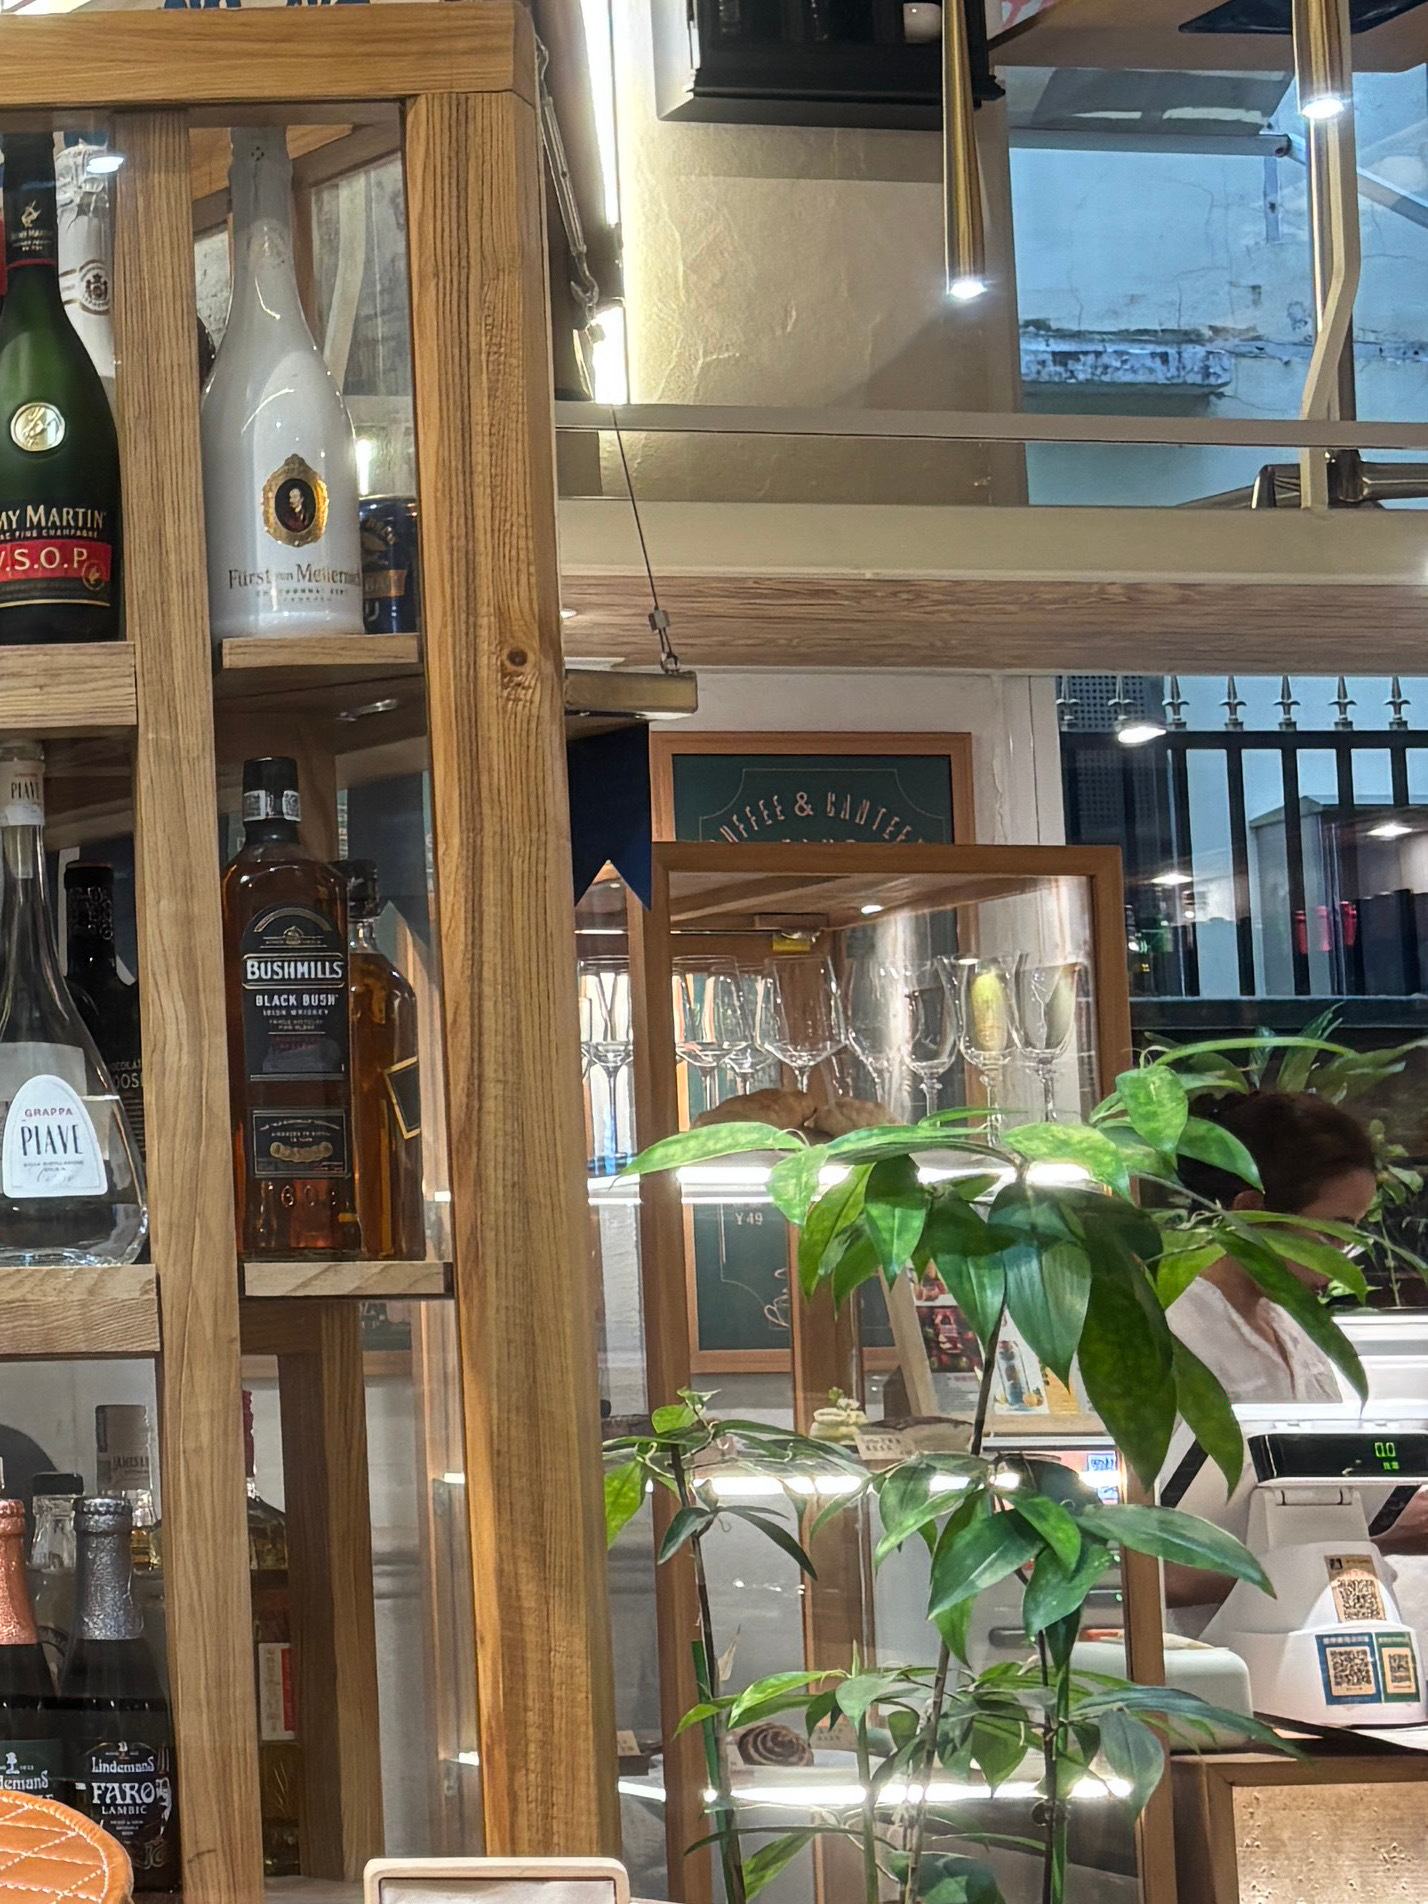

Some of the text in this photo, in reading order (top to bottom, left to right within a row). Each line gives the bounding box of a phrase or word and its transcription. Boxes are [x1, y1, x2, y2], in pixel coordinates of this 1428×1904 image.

[26, 504, 105, 530] MARTIN
[795, 792, 814, 816] &
[246, 960, 344, 979] BUSHMILLS
[256, 994, 335, 1007] BLACK BUSH
[25, 1107, 73, 1118] GRAPPA
[20, 1123, 83, 1157] PIAVE
[92, 1781, 156, 1804] FARO
[102, 1805, 147, 1815] LAMBIC
